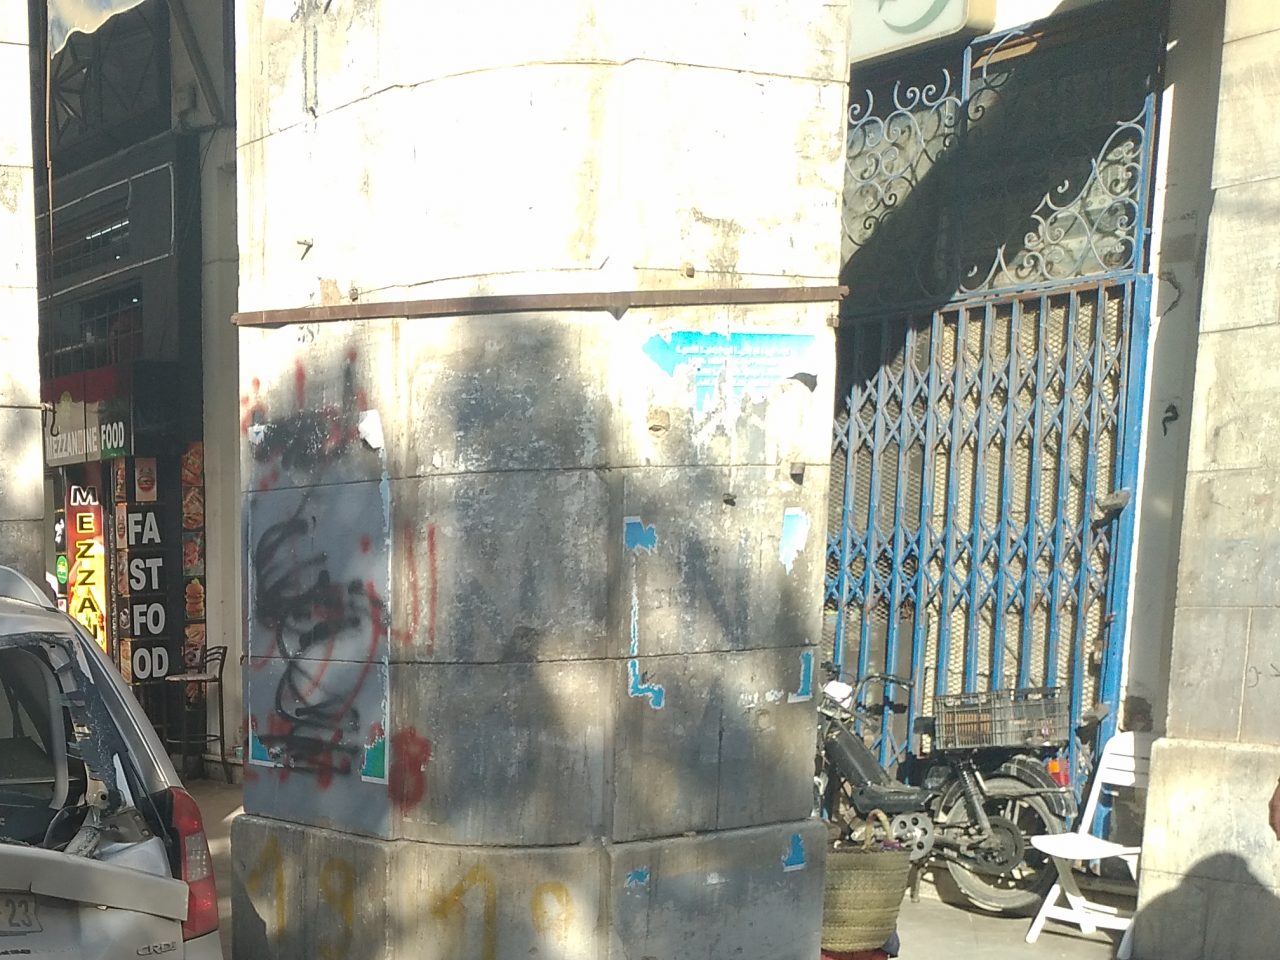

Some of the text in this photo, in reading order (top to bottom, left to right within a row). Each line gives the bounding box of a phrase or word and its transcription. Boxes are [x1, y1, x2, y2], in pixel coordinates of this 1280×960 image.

[100, 421, 125, 450] FOOD
[128, 511, 162, 546] FA
[129, 557, 163, 592] ST
[132, 602, 166, 637] FO
[132, 646, 170, 680] OD
[5, 897, 33, 928] 23
